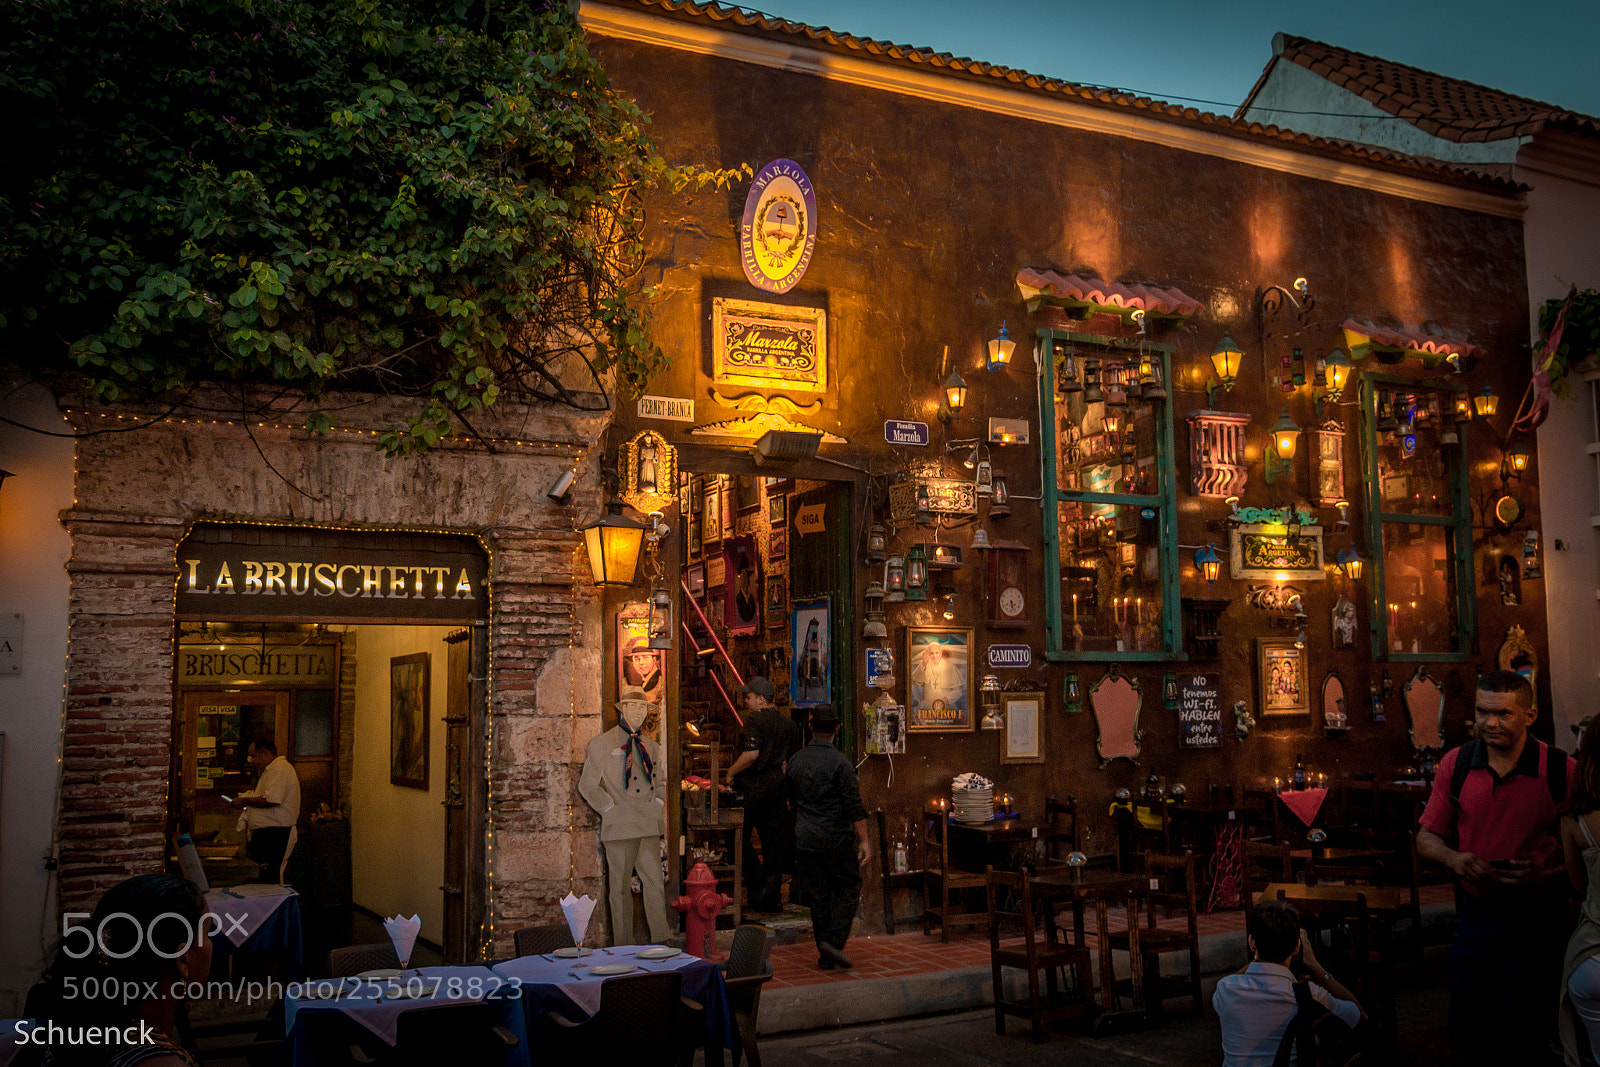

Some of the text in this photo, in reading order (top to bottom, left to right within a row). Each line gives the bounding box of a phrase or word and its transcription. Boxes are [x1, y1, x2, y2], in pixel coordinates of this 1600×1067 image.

[756, 164, 811, 196] MARZOLA
[742, 223, 815, 290] PARRILLA ARGENTINA
[740, 331, 799, 351] Marzola
[893, 429, 921, 443] Marzola
[802, 513, 819, 525] SIGA
[185, 559, 476, 600] LA BRUSCHETTA
[990, 649, 1030, 663] CAMINITO
[185, 653, 330, 677] BRUSCHETTA
[1193, 676, 1207, 686] NO
[1182, 687, 1217, 698] tenemos
[917, 709, 957, 720] FRANCISCO
[1180, 709, 1221, 720] HABLEN
[1190, 721, 1212, 733] entre
